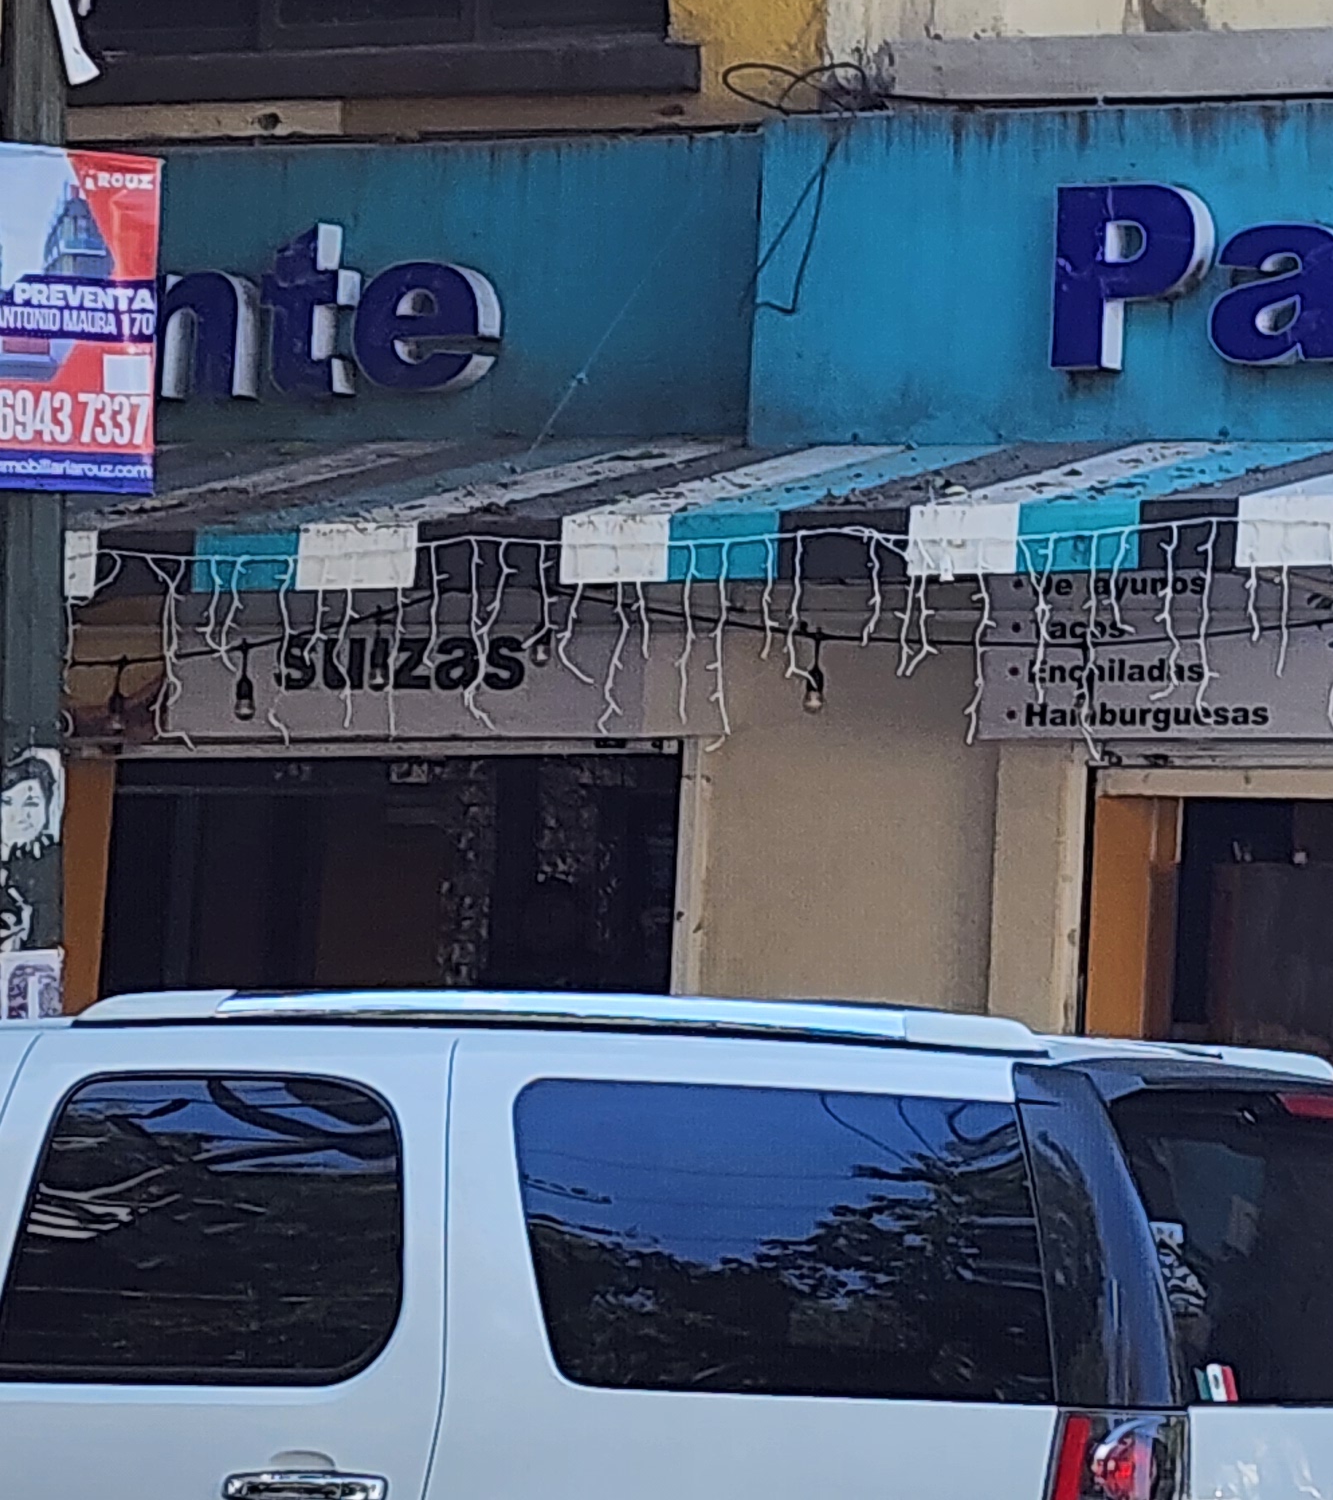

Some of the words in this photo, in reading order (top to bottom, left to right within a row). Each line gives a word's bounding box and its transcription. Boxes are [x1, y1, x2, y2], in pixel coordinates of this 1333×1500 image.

[13, 282, 154, 311] PREVENTA
[120, 312, 154, 337] 170
[0, 388, 73, 443] 6943
[77, 391, 151, 446] 7337
[0, 457, 153, 480] mobiliariarouz.com
[1032, 575, 1206, 600] Deayunos
[1024, 702, 1269, 732] Hamburguesas
